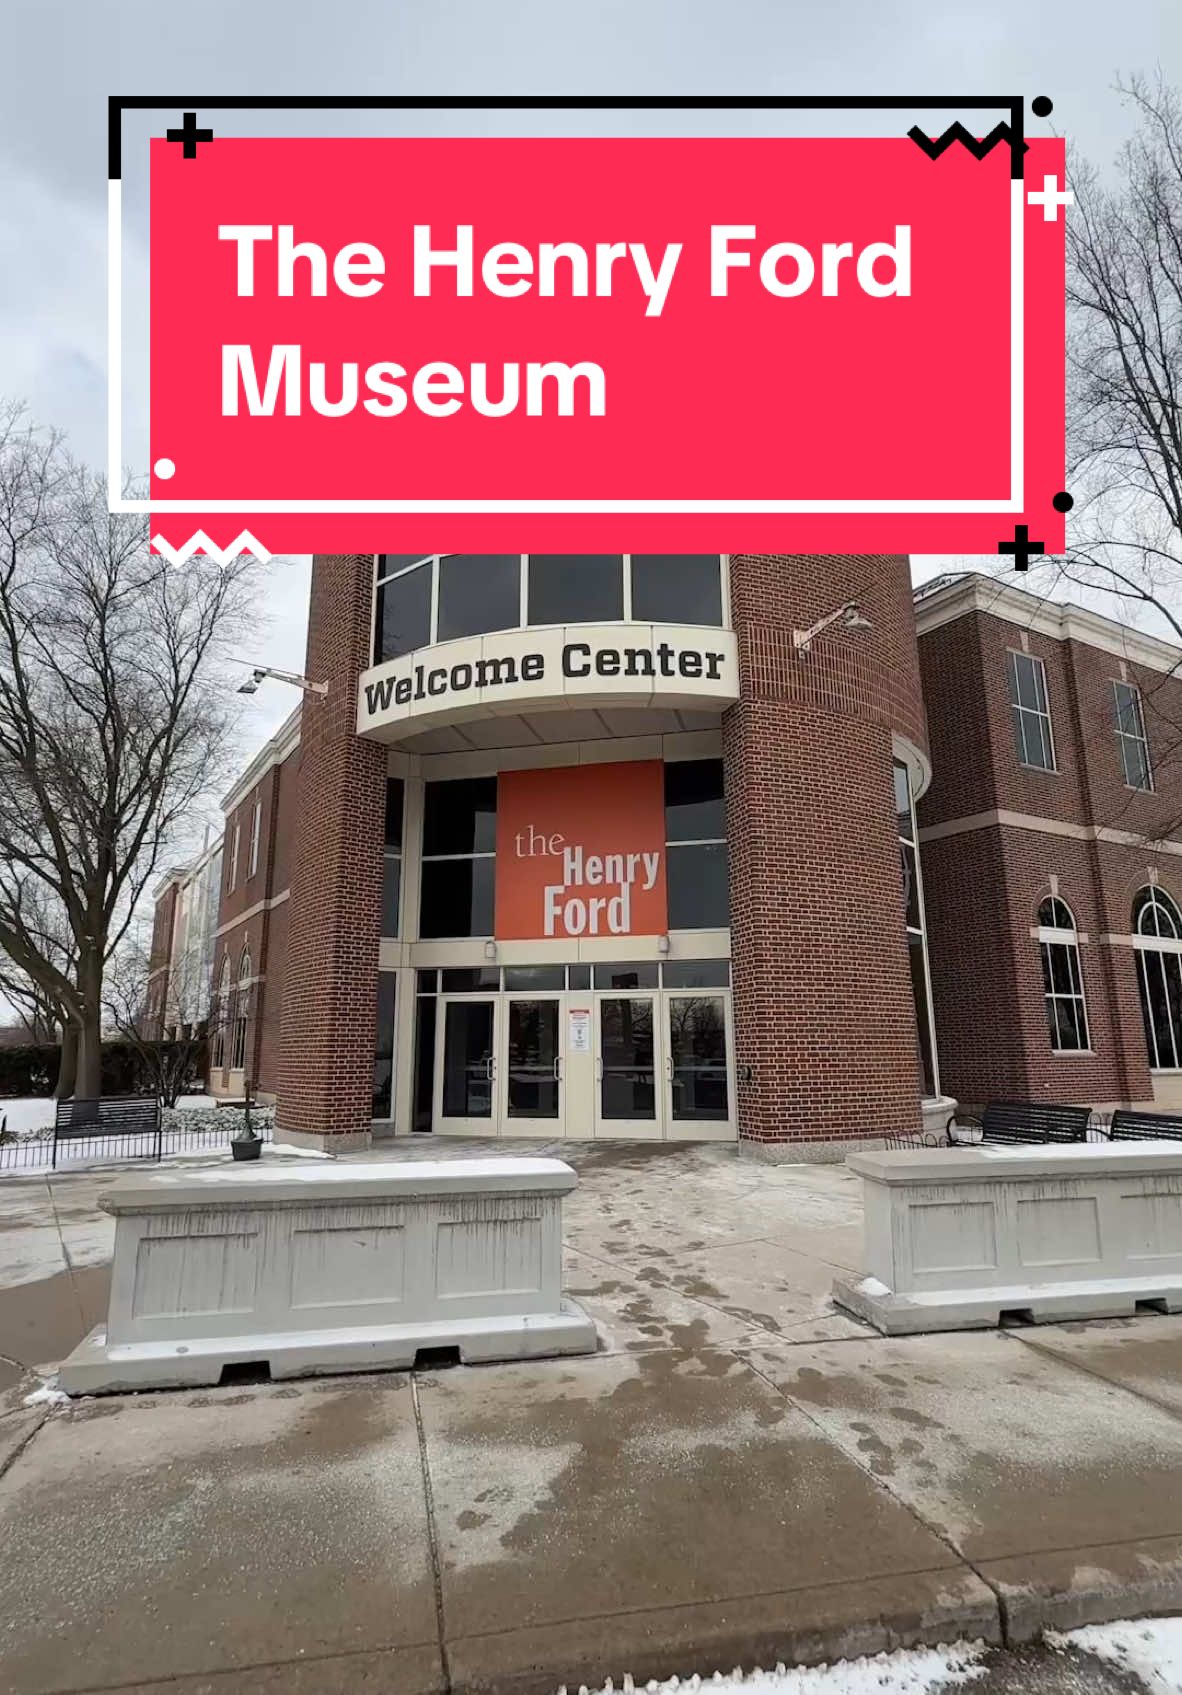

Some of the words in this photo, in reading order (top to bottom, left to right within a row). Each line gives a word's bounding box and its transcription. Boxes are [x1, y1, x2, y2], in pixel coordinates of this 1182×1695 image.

[364, 653, 545, 715] Welcome
[562, 643, 725, 680] Center
[515, 824, 566, 857] the
[563, 845, 660, 890] Henry
[543, 881, 631, 936] Ford
